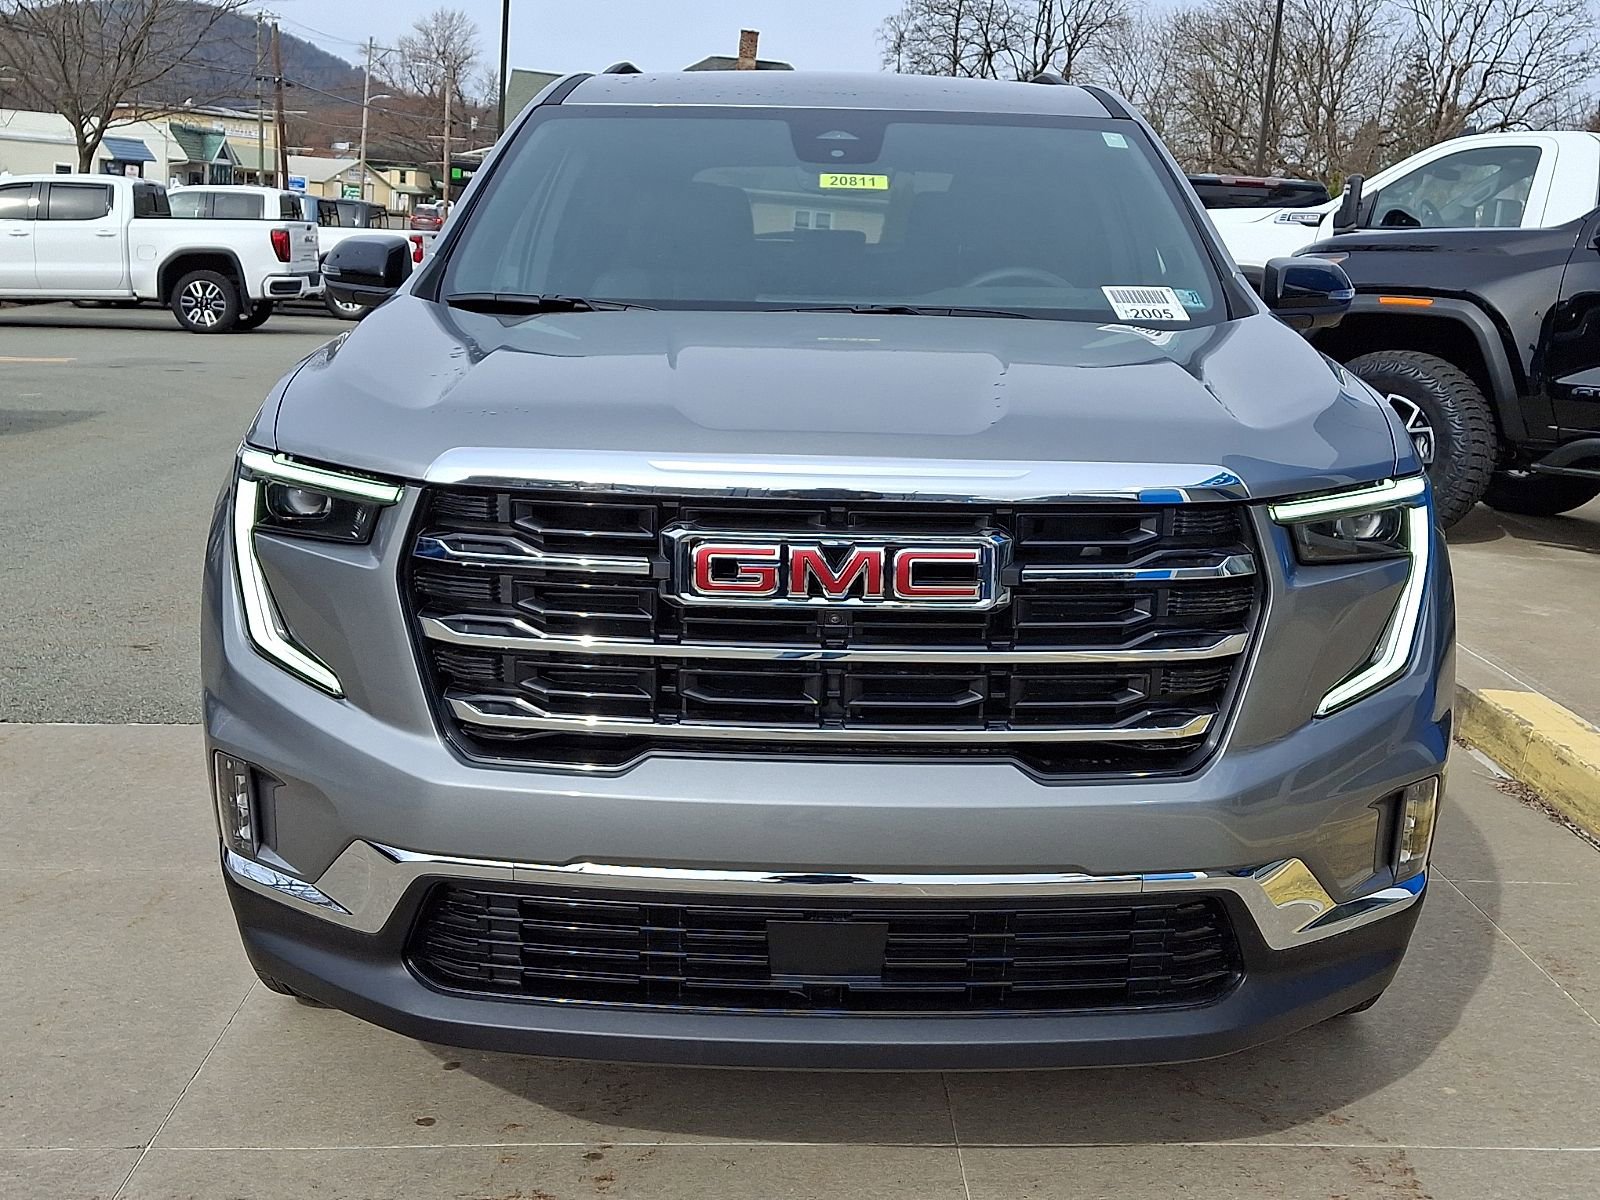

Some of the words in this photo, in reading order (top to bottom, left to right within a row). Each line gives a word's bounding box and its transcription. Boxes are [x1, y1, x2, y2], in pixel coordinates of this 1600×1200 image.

[829, 175, 875, 187] 20811
[1130, 308, 1174, 319] 2005
[691, 543, 982, 600] GMC
